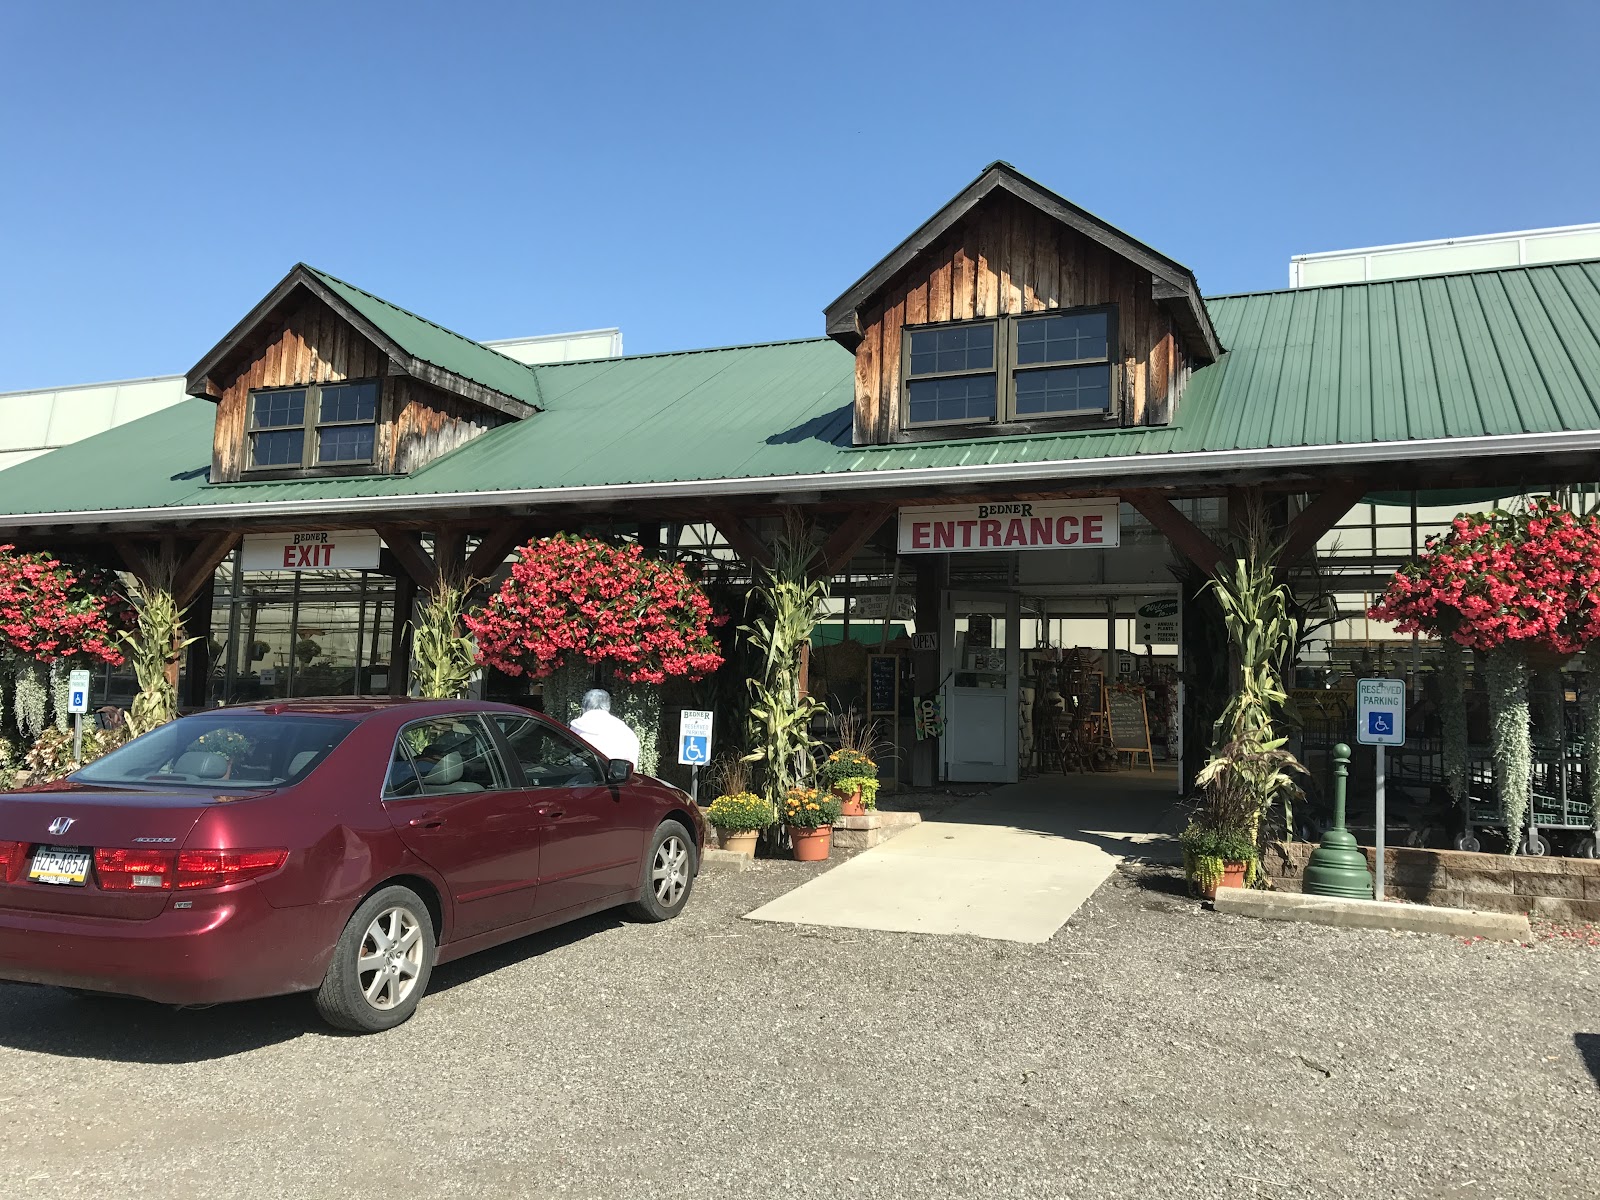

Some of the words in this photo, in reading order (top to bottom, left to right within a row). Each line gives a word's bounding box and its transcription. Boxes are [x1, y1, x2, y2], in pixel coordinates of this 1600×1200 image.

[977, 503, 1033, 518] BEDNER
[293, 532, 328, 545] BEDNER
[912, 515, 1103, 548] ENTRANCE
[283, 544, 335, 567] EXIT
[913, 634, 936, 649] OPEN
[1361, 684, 1401, 695] RESERVED
[1363, 696, 1399, 706] PARKING
[683, 711, 710, 720] BEDNER
[921, 699, 937, 739] OPEN
